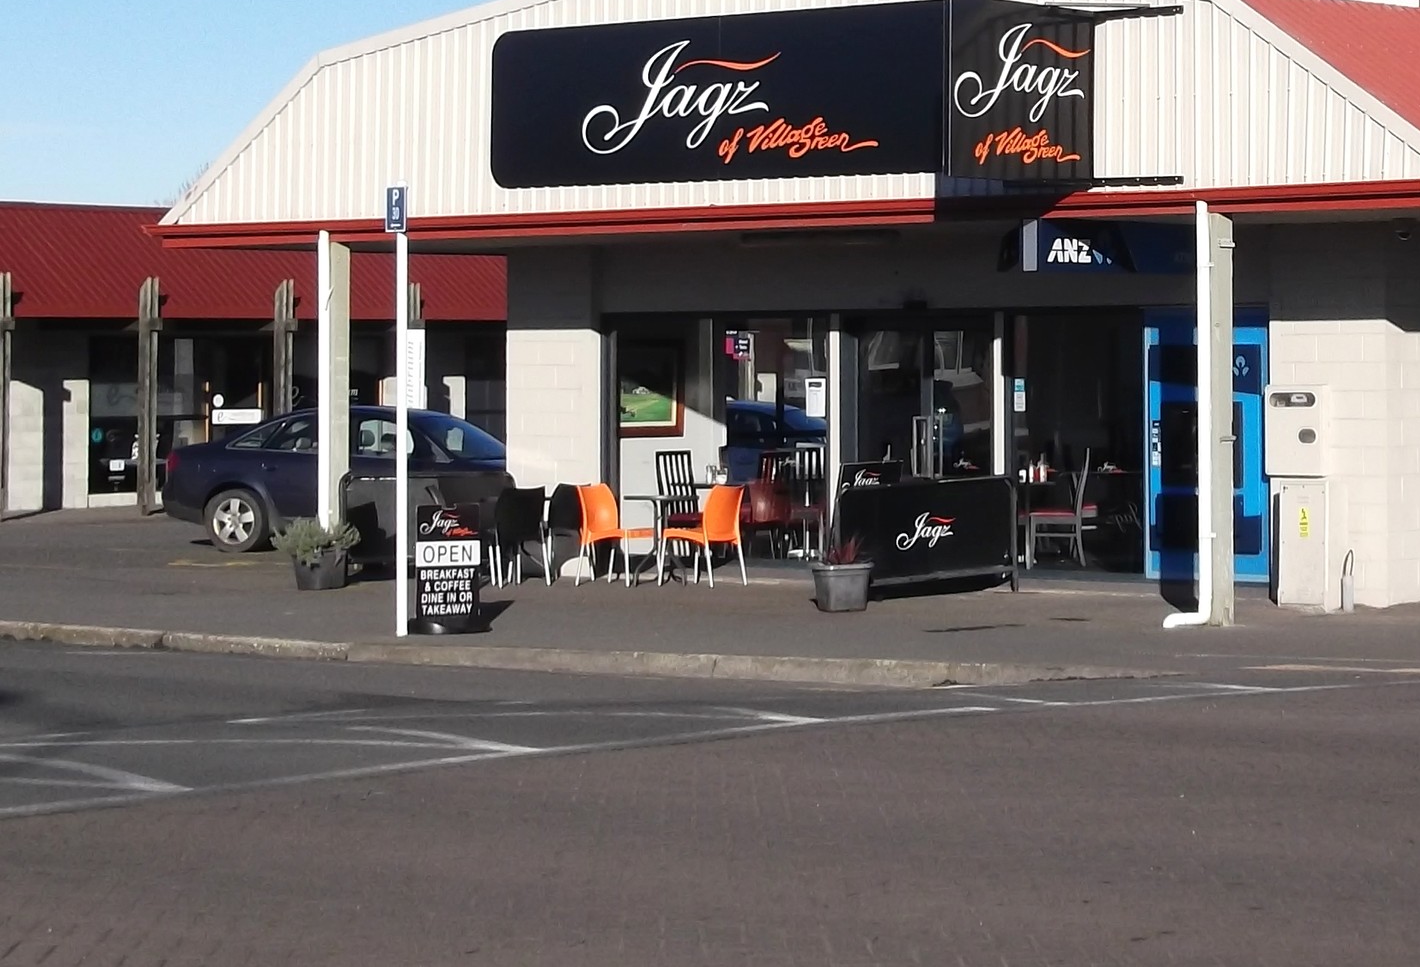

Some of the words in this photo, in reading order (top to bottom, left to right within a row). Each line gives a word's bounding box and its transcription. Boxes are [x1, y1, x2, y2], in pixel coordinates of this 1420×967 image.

[954, 23, 1085, 122] Jagz
[582, 40, 769, 154] Jagz
[719, 128, 744, 164] of
[746, 118, 827, 154] Village
[975, 134, 993, 165] of
[392, 189, 400, 206] P
[1047, 238, 1092, 263] ANZ
[420, 510, 459, 535] Jagz
[896, 512, 953, 550] Jagz
[423, 545, 473, 563] OPEN
[420, 569, 475, 580] BREAKFAST
[425, 582, 431, 592] &
[434, 580, 471, 591] COFFEE
[421, 593, 444, 604] DINE
[447, 592, 457, 603] IN
[459, 591, 473, 602] OR
[421, 603, 473, 616] TAKEAWAY
